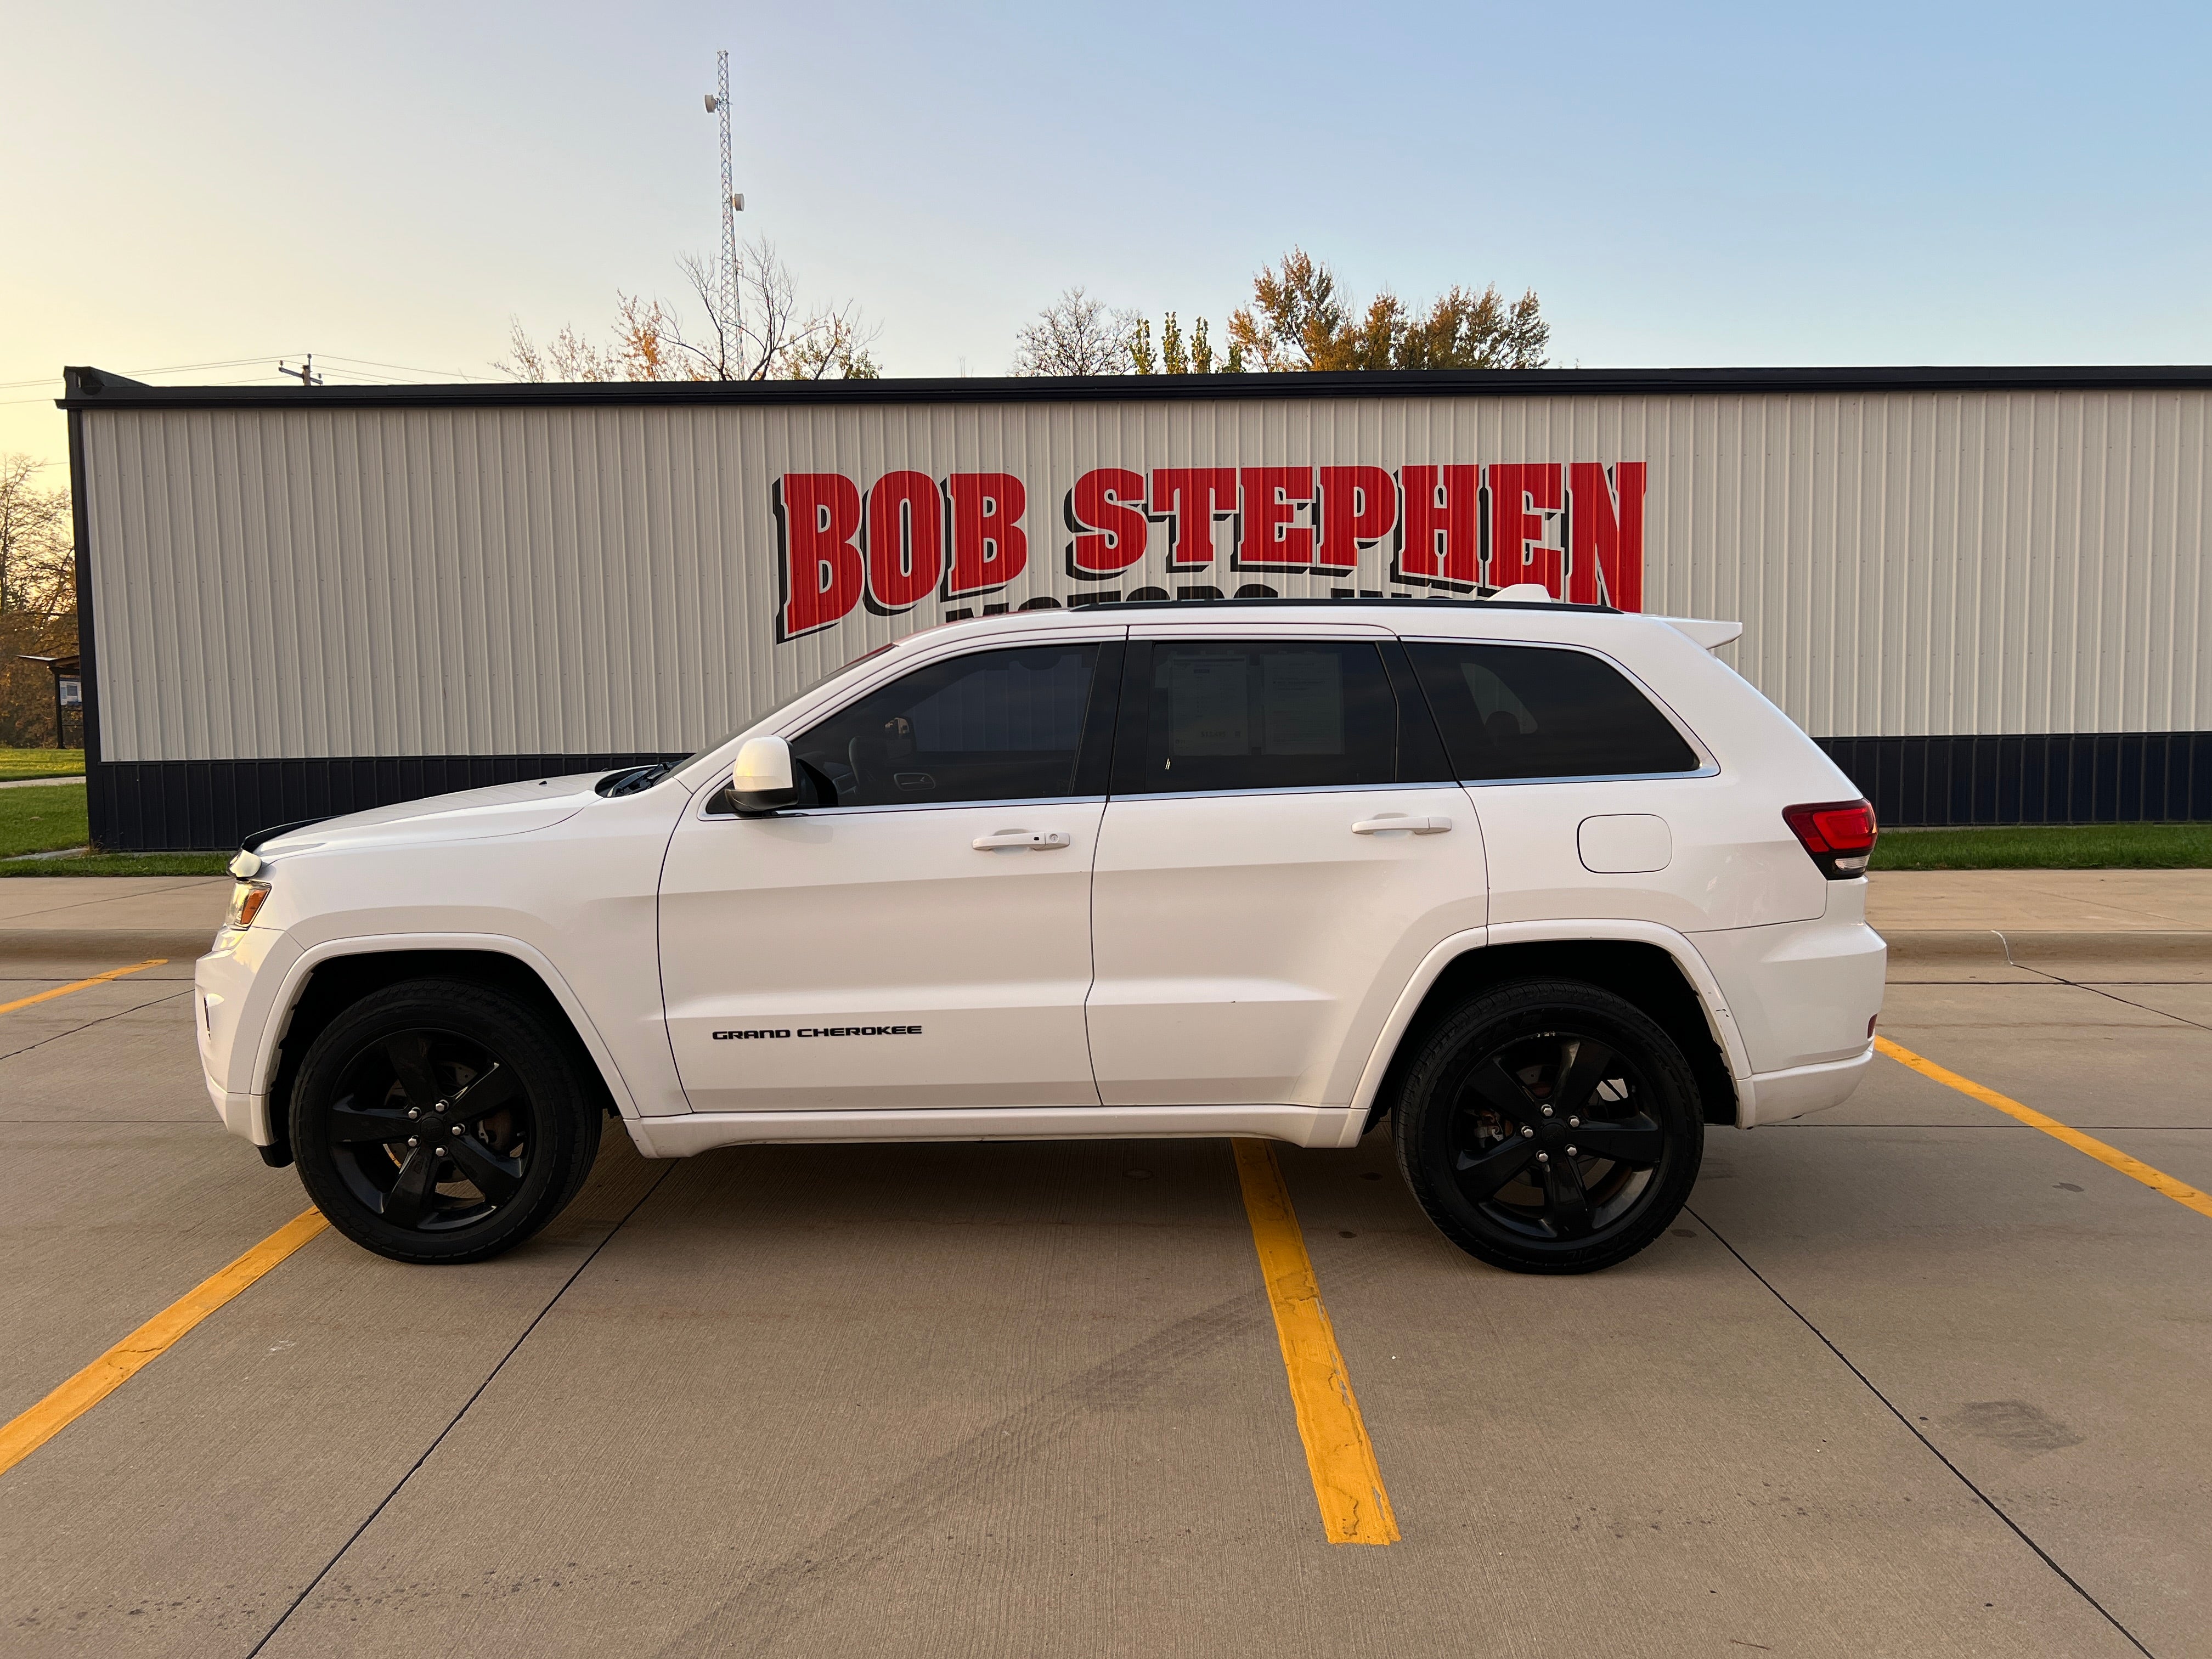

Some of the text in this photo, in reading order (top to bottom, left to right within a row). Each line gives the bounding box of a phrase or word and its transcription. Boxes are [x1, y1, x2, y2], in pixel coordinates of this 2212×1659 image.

[772, 461, 1647, 644] BOB STEPHEN
[712, 1025, 922, 1040] GRAND CHEROKEE
